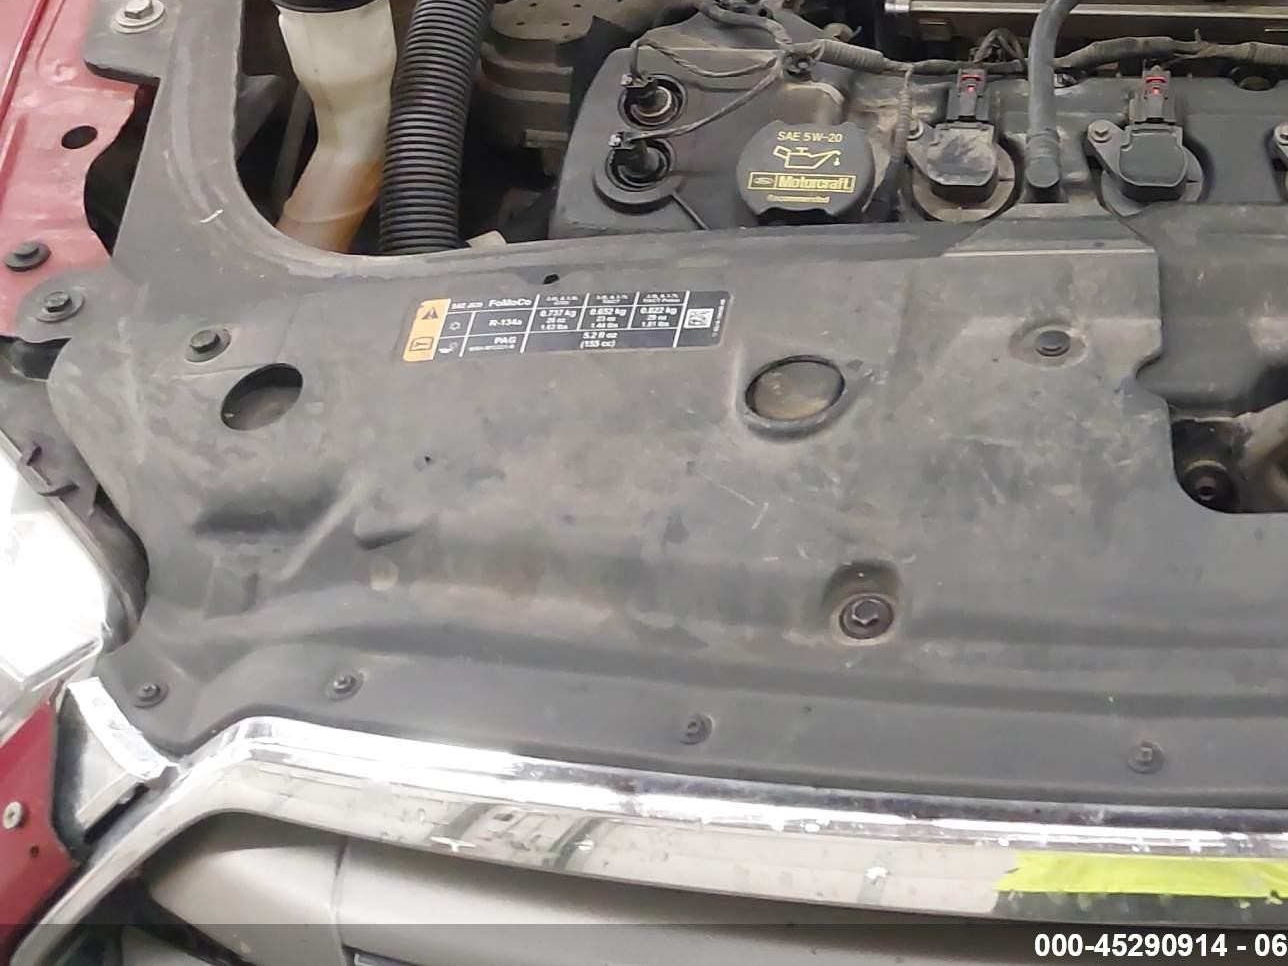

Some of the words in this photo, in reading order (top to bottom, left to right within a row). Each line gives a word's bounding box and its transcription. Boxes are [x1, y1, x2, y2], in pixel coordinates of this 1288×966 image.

[777, 131, 801, 142] SAE
[803, 132, 844, 144] 5W-20
[778, 175, 851, 190] Motorcraft
[488, 298, 532, 307] FoMoCo
[564, 309, 577, 318] kg
[614, 307, 627, 316] kg
[665, 306, 677, 315] kg
[488, 319, 523, 327] R-134a
[494, 336, 517, 345] PAG
